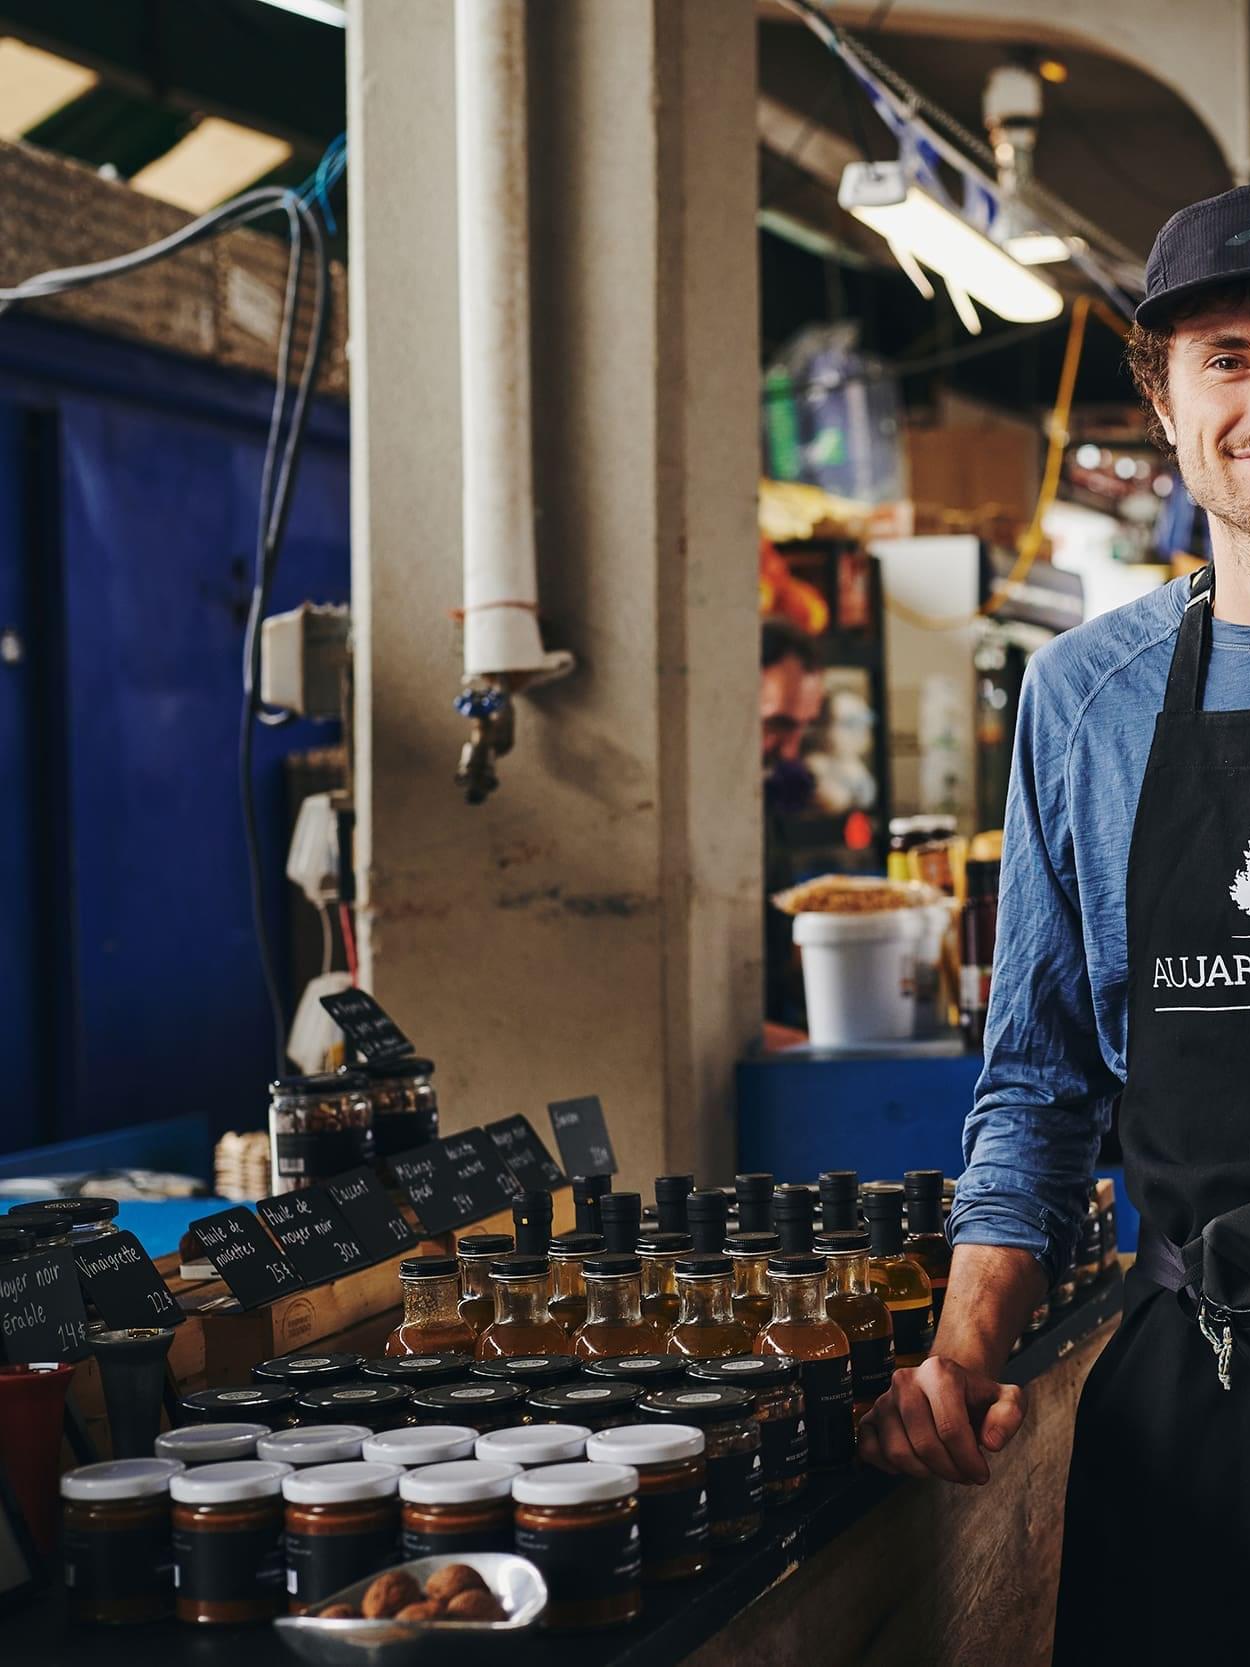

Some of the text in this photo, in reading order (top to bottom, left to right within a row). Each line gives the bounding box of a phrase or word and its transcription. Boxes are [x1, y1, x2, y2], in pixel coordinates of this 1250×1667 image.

[263, 1199, 313, 1227] Huile de
[195, 1220, 245, 1248] Huile de
[280, 1218, 333, 1246] noyer noir
[75, 1245, 141, 1278] Vinaigrette
[216, 1241, 256, 1268] noisettes
[333, 1241, 361, 1263] 30$
[36, 1260, 60, 1287] noir
[265, 1261, 295, 1284] 25$
[2, 1302, 47, 1335] érable
[57, 1320, 87, 1352] 14$
